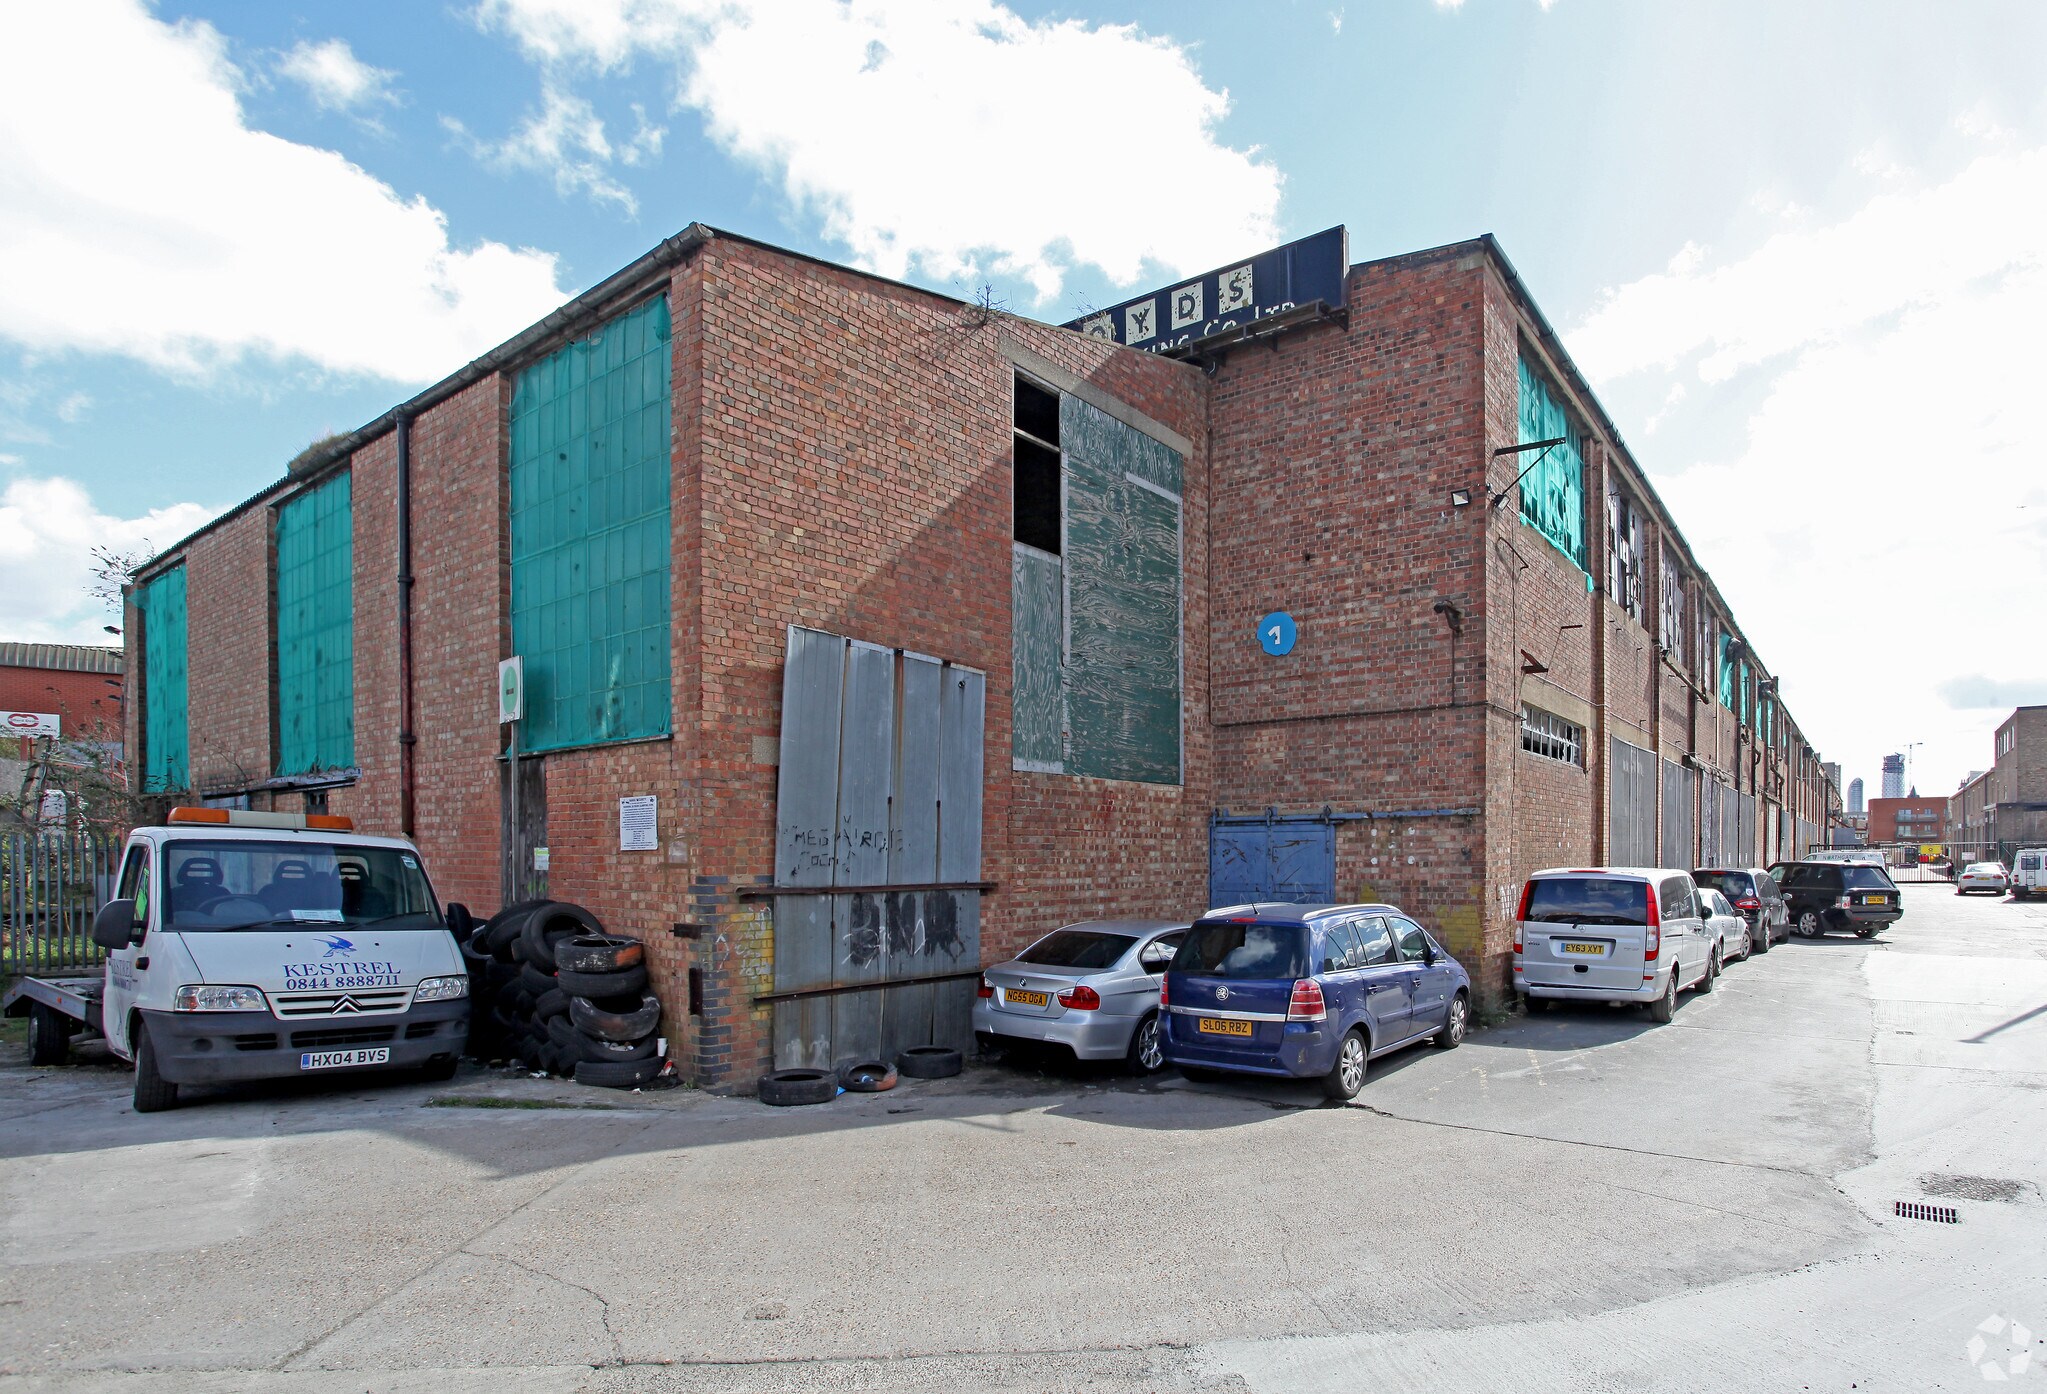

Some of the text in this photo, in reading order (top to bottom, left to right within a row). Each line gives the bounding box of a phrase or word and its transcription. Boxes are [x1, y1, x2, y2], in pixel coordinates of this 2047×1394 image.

[1267, 625, 1281, 645] 1
[1565, 943, 1604, 955] EY63 XYT
[282, 961, 402, 979] KESTREL
[286, 975, 400, 991] 0844 8888711
[1007, 990, 1043, 1005] NG55 OGA
[1203, 1019, 1248, 1033] SL06 RBZ
[311, 1049, 387, 1067] HX04 BVS
